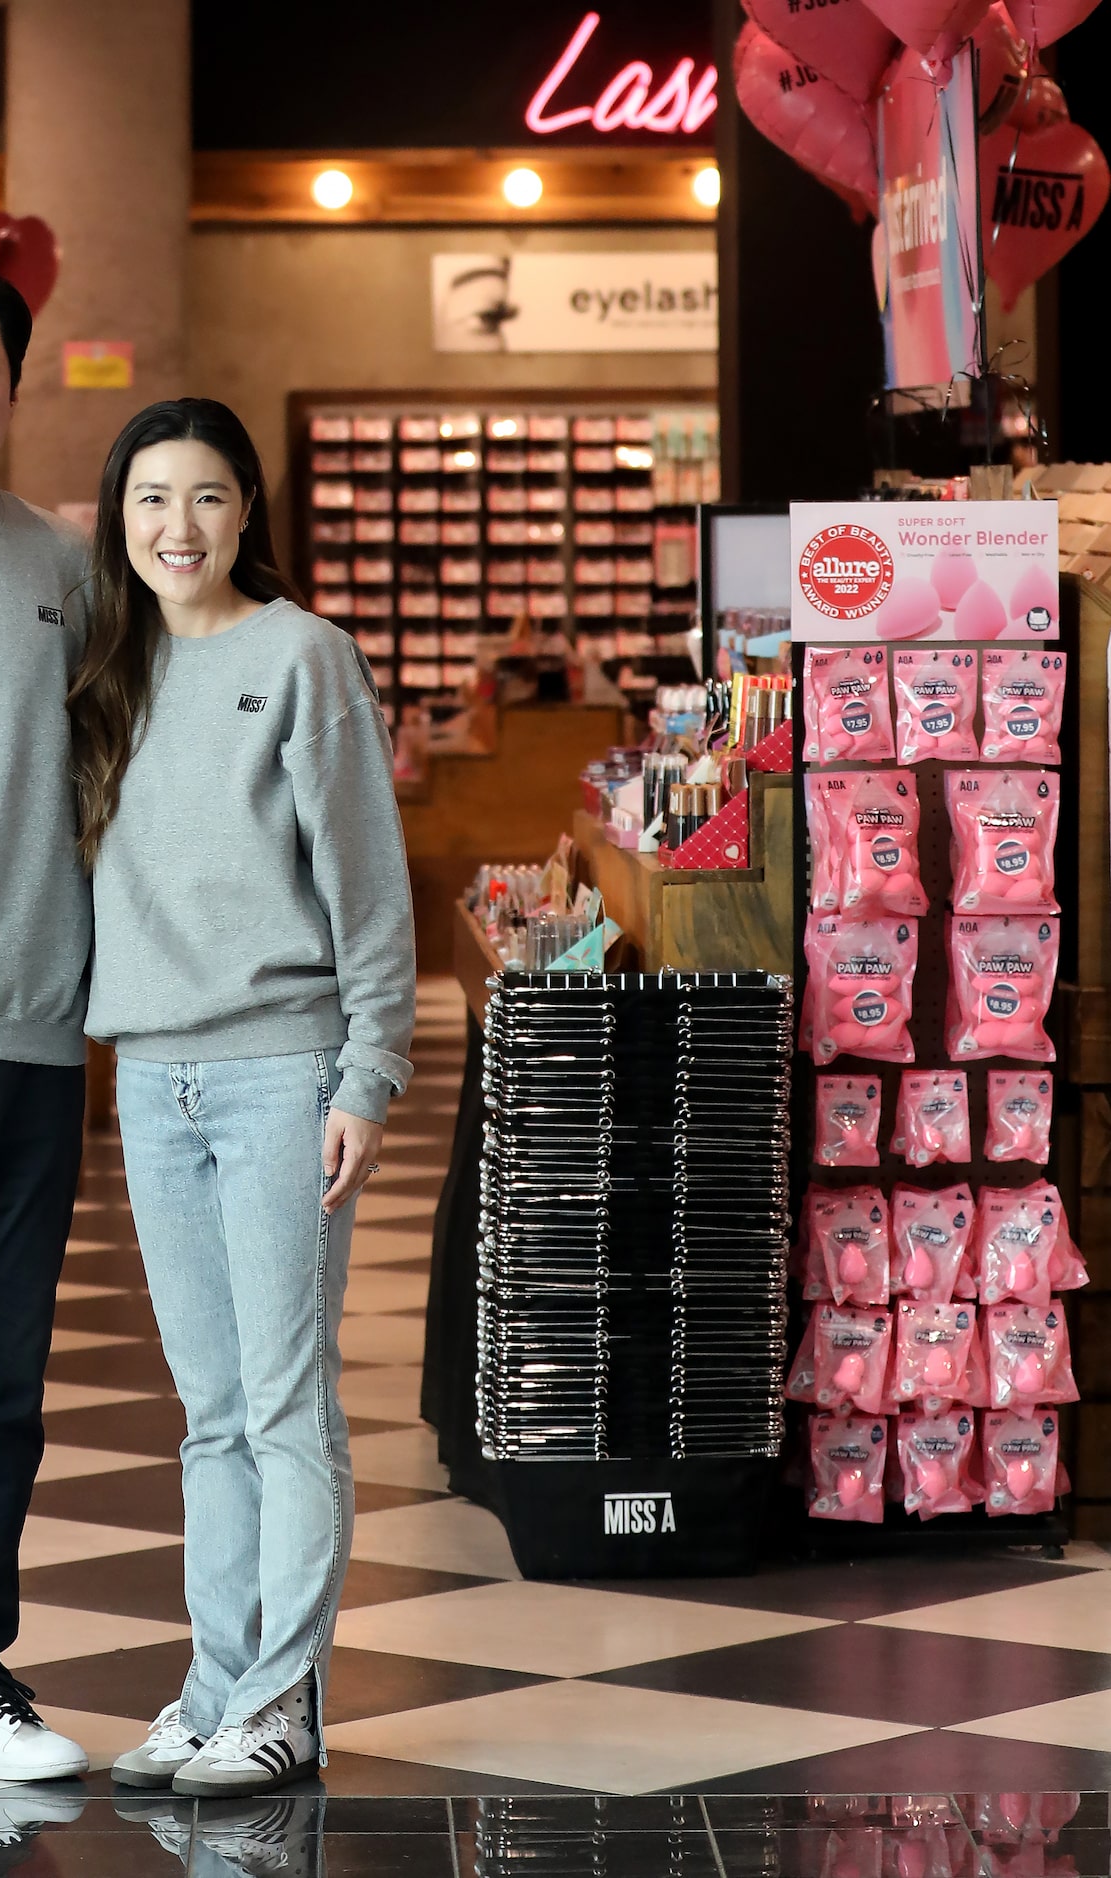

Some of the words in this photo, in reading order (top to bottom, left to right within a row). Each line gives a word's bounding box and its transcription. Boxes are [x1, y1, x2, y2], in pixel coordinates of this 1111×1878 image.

[992, 175, 1065, 231] MISS
[1066, 183, 1085, 231] A
[898, 517, 934, 527] SUPER
[937, 517, 966, 527] SOFT
[898, 531, 972, 546] Wonder
[976, 530, 1049, 546] Blender
[801, 533, 826, 567] BEST
[828, 525, 846, 538] OF
[850, 526, 892, 567] BEAUTY
[813, 557, 880, 578] allure
[834, 584, 859, 594] 2022
[801, 583, 840, 618] AWARD
[844, 581, 892, 619] WINNER
[38, 607, 59, 625] MISS
[898, 655, 914, 665] AOA
[831, 686, 850, 696] PAW
[914, 686, 934, 695] PAW
[936, 686, 957, 695] PAW
[1002, 686, 1023, 696] PAW
[1024, 687, 1045, 696] PAW
[237, 696, 262, 713] MISS
[847, 718, 868, 729] $7.95
[926, 718, 949, 730] $7.95
[1011, 722, 1035, 733] $7.95
[827, 780, 846, 790] AOA
[960, 780, 980, 792] AOA
[856, 813, 879, 824] PAW
[880, 814, 903, 824] PAW
[876, 853, 897, 864] $8.95
[1001, 857, 1025, 868] $8.95
[817, 923, 837, 934] AOA
[959, 922, 978, 933] AOA
[837, 963, 863, 973] PAW
[865, 963, 891, 974] PAW
[979, 962, 1005, 972] PAW
[1006, 963, 1033, 973] PAW
[989, 1000, 1013, 1011] $8.95
[858, 1008, 882, 1019] $8.95
[604, 1500, 656, 1535] MISS
[661, 1499, 676, 1533] A
